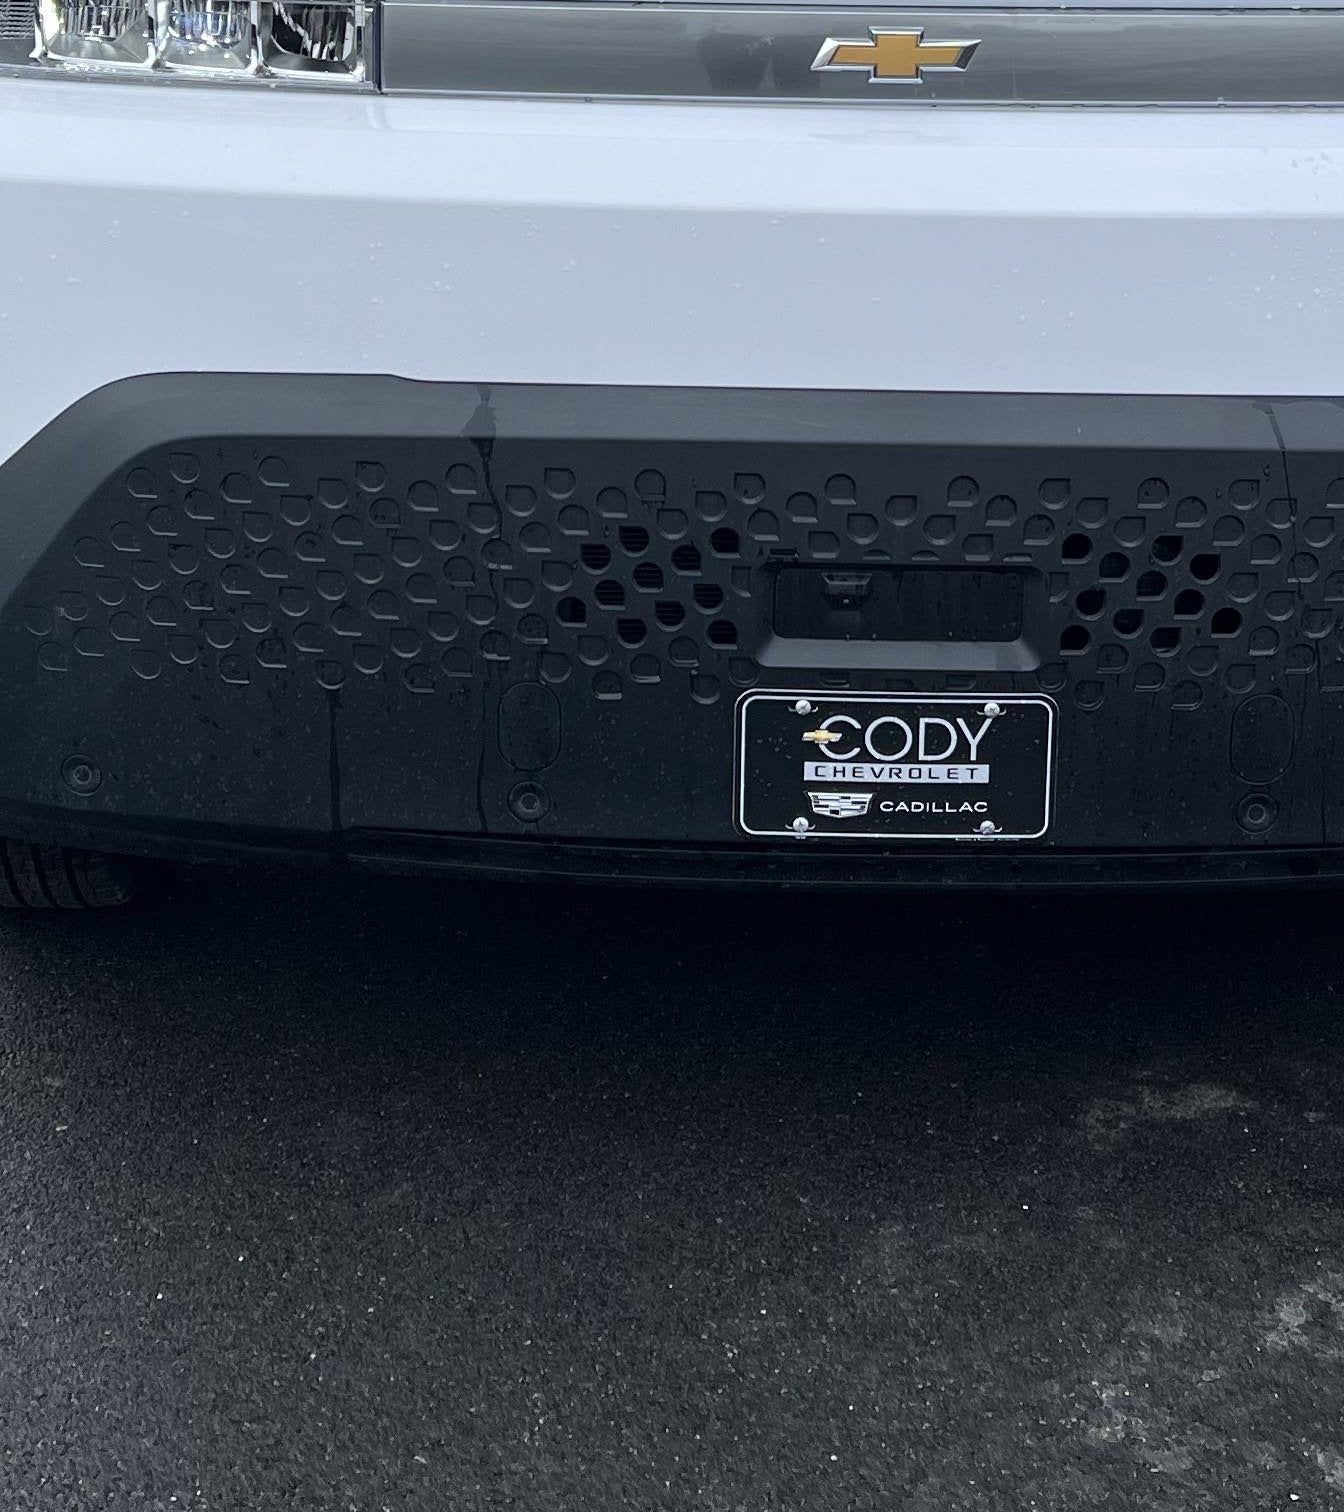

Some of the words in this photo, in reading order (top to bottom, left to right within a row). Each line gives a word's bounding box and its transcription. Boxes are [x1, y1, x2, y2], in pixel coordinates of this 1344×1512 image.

[817, 714, 994, 762] CODY
[814, 764, 980, 780] CHEVROLET
[879, 800, 989, 813] CADILLAC
